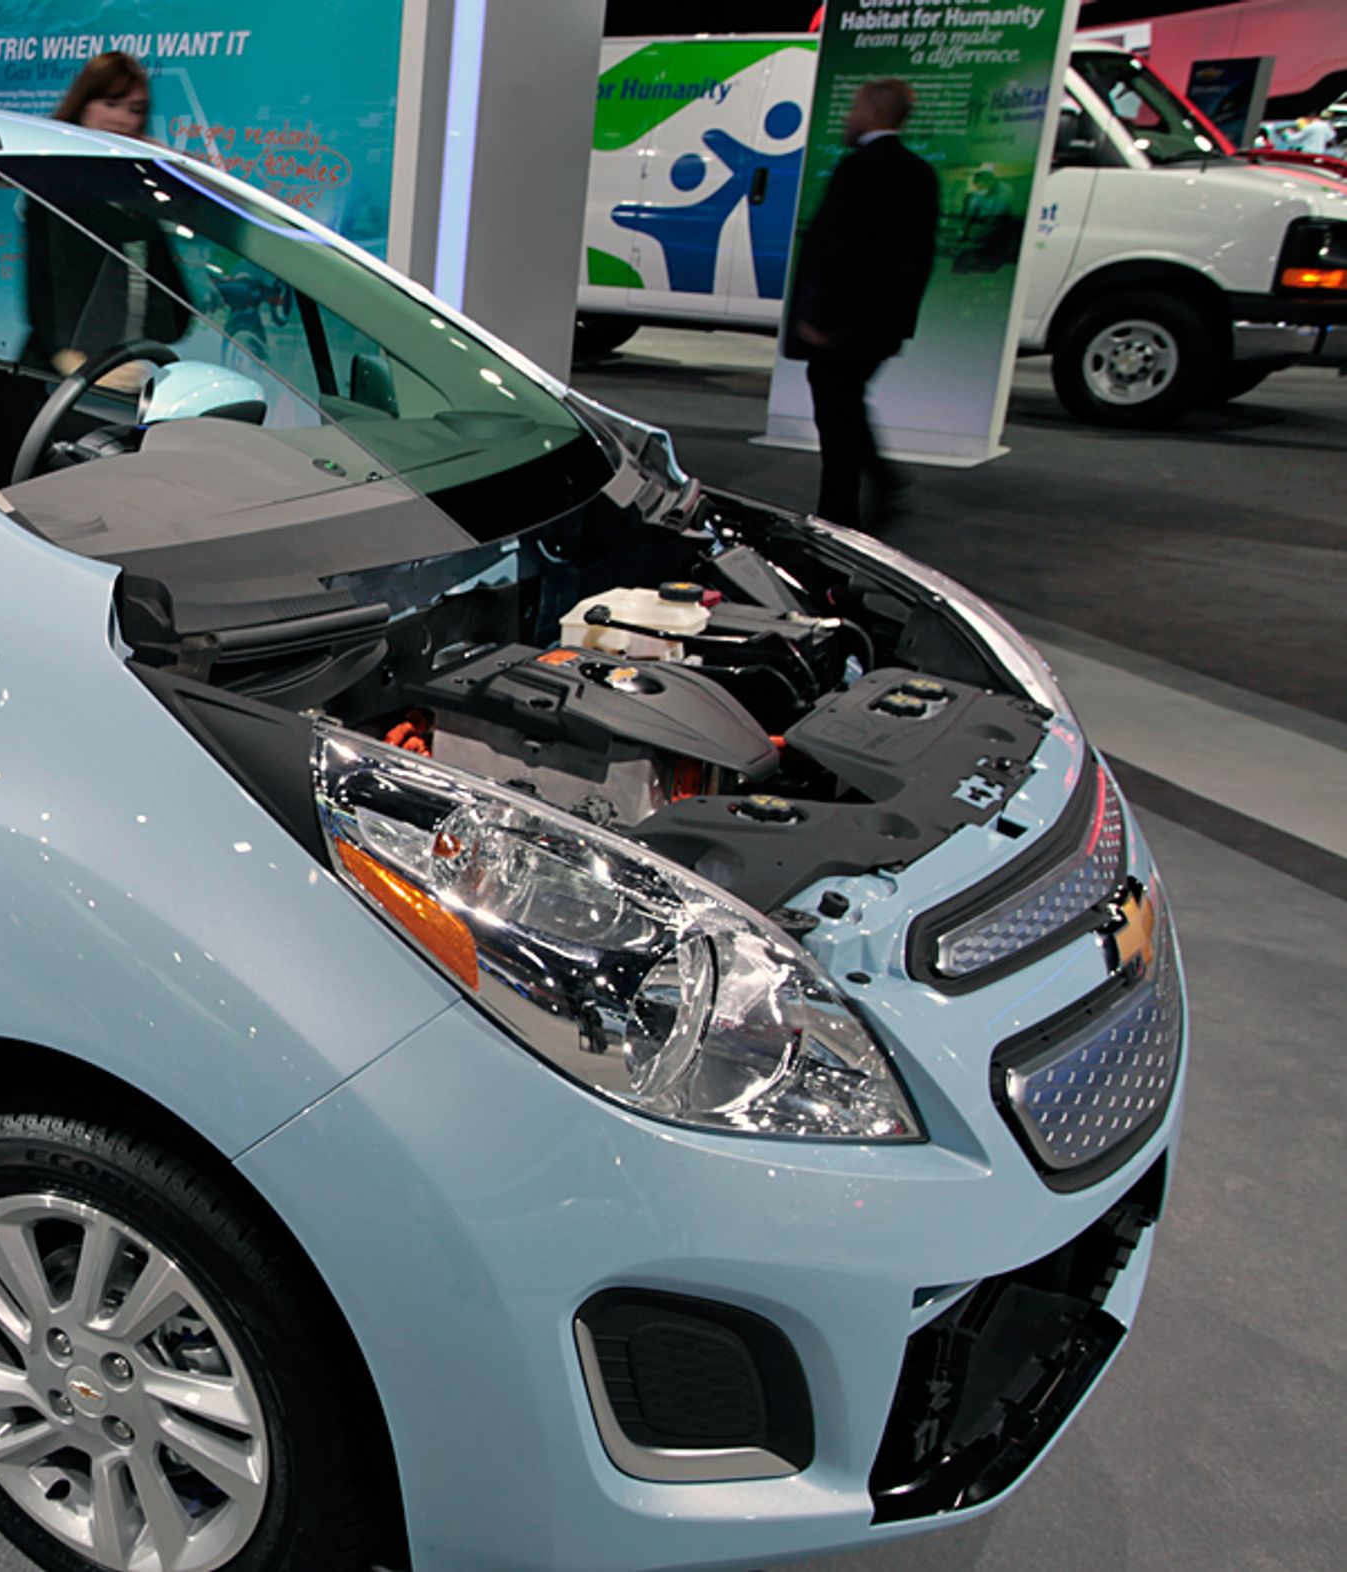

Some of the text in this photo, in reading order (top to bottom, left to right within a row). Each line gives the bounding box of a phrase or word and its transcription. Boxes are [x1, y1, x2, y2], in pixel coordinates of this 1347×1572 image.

[840, 5, 1044, 30] Habitat for Humanity
[41, 35, 102, 60] WHEN
[110, 33, 152, 58] YOU
[156, 31, 225, 57] WANT
[226, 30, 251, 56] IT
[854, 24, 1004, 52] team up to make
[910, 45, 1021, 68] a difference.
[4, 63, 32, 81] Gas
[35, 62, 77, 80] When
[620, 76, 733, 105] Humanity
[169, 116, 237, 149] Charging
